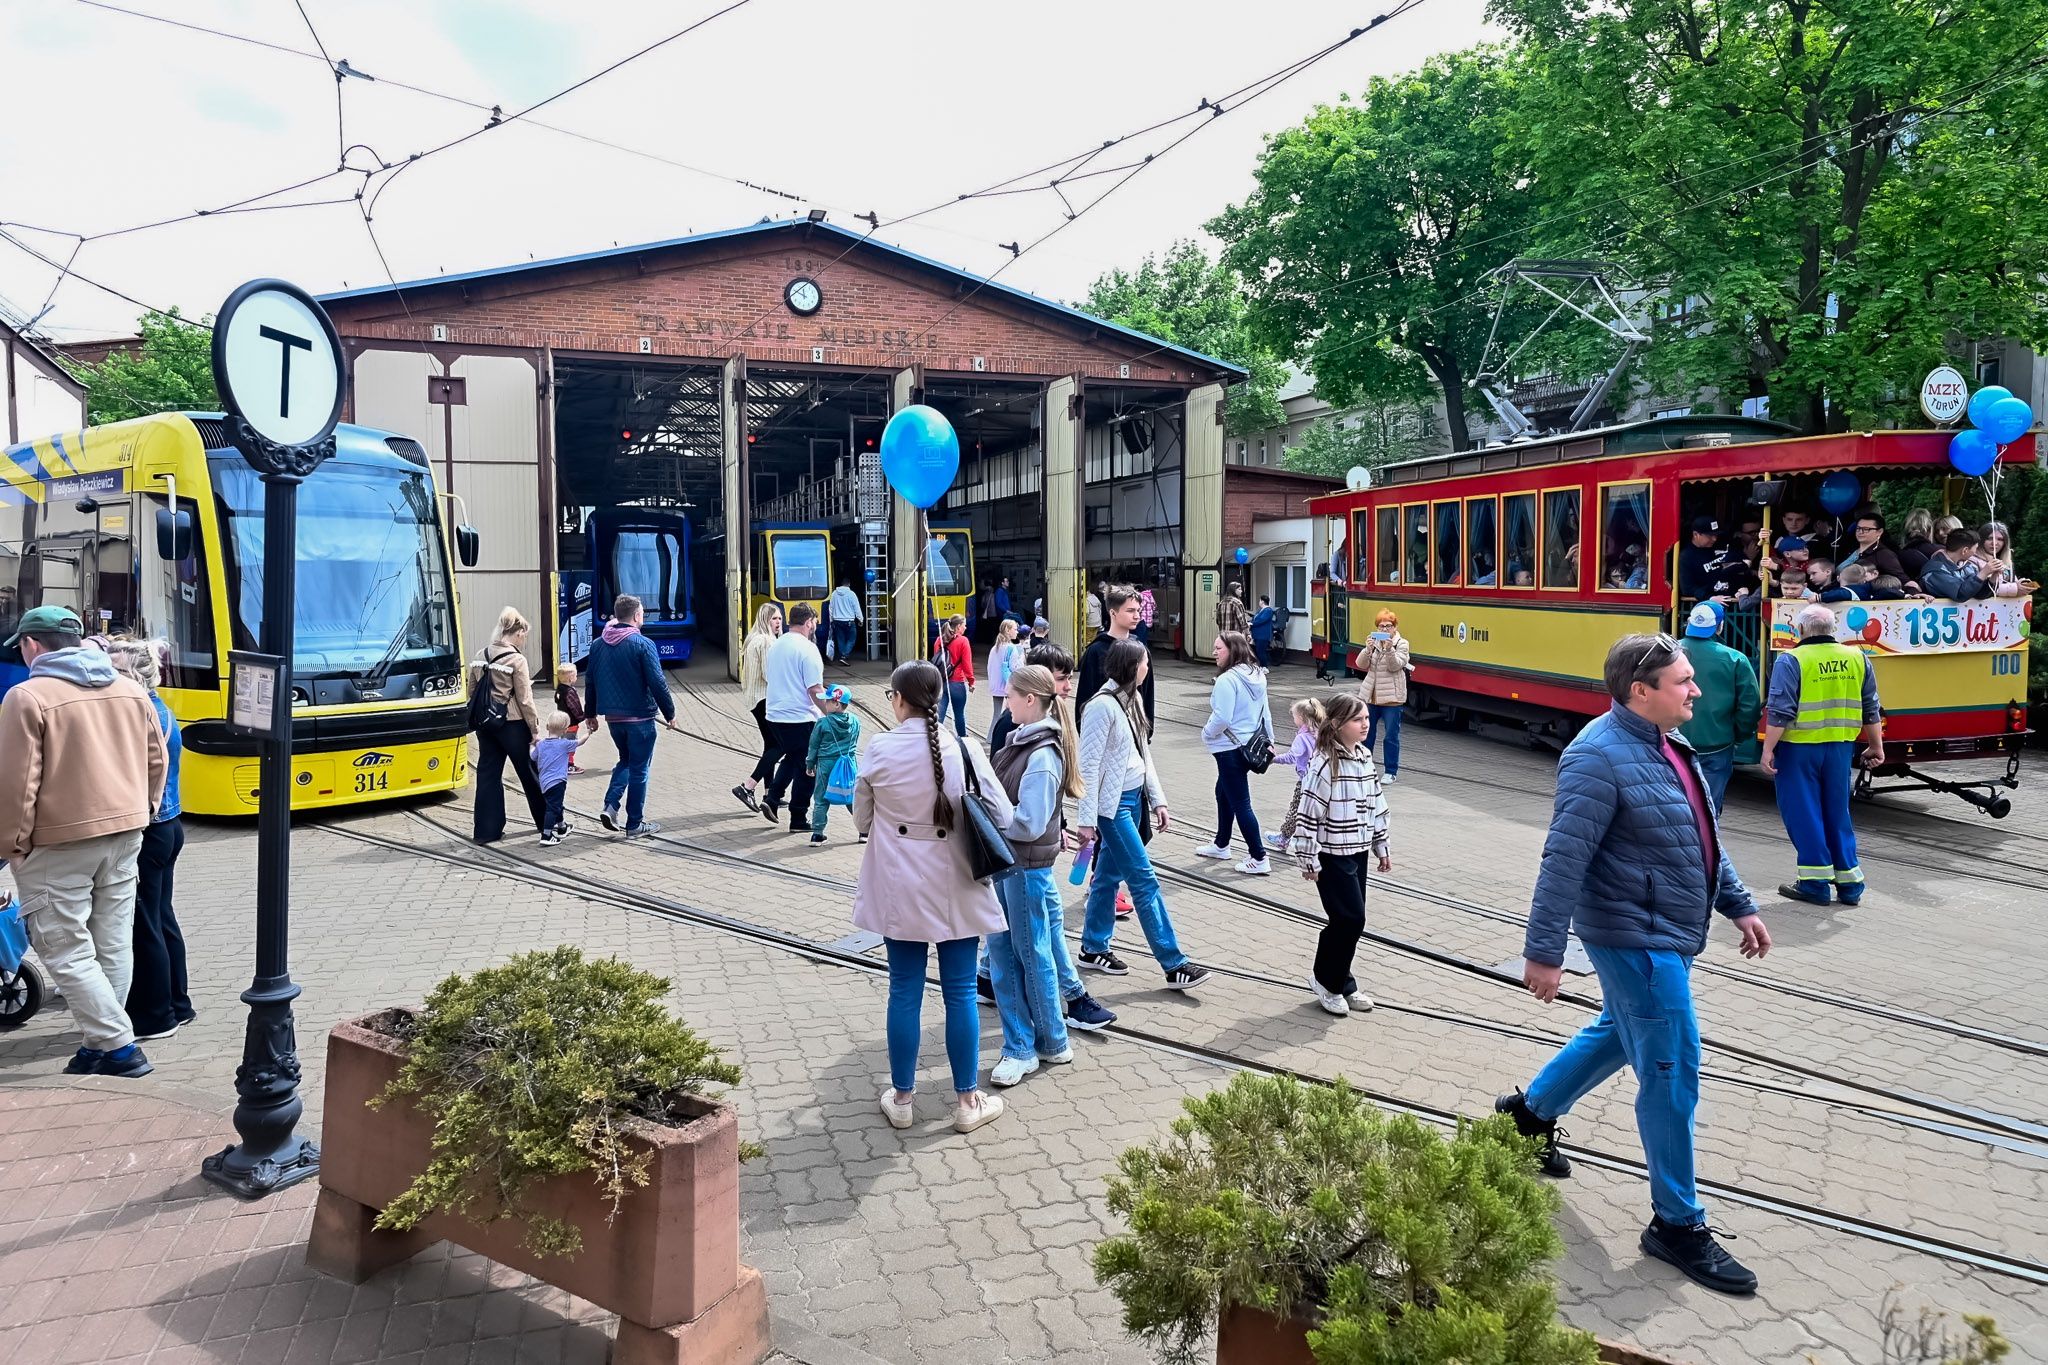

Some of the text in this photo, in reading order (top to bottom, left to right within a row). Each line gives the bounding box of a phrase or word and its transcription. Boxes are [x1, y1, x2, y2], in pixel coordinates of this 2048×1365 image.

[437, 328, 442, 338] 1
[643, 341, 649, 350] 2
[815, 350, 821, 360] 3
[977, 359, 982, 369] 4
[260, 324, 312, 418] T
[1122, 367, 1128, 376] 5
[1928, 383, 1961, 396] MZK
[943, 602, 955, 611] 214
[1440, 624, 1454, 638] MZK
[1905, 607, 1998, 646] 135 lat
[660, 645, 675, 654] 325
[1819, 660, 1848, 674] MZK
[1991, 653, 2020, 676] 100
[354, 770, 388, 793] 314
